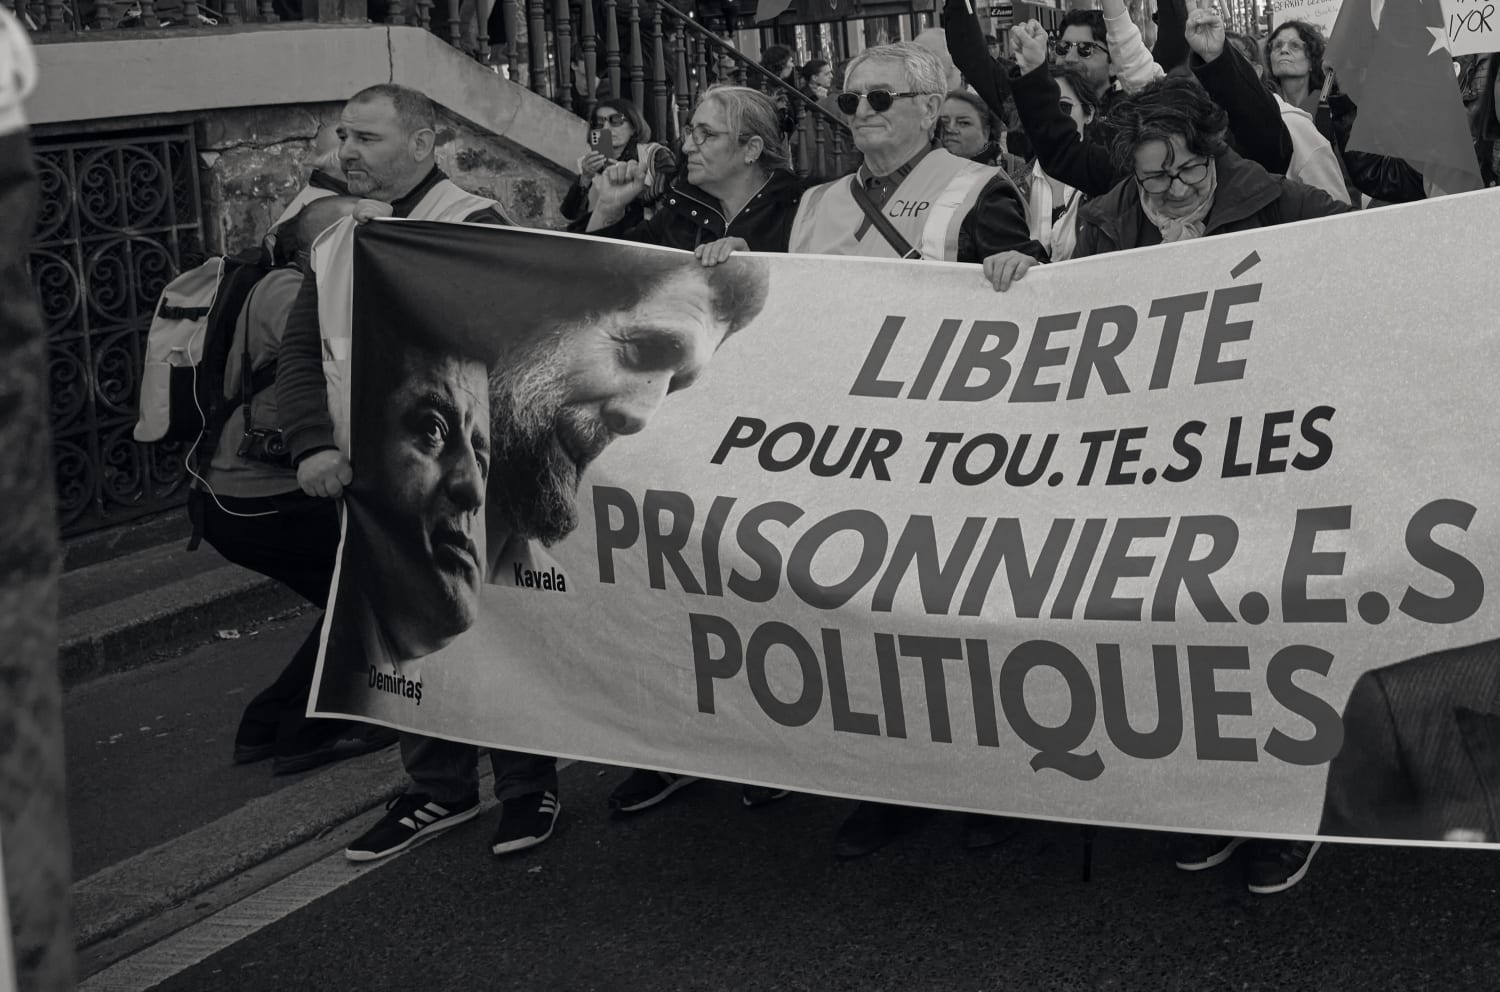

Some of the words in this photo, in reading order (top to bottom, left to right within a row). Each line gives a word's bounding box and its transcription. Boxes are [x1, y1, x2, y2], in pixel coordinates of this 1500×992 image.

[889, 199, 930, 218] CHP
[848, 251, 1263, 403] LIBERTÉ
[710, 416, 904, 483] POUR
[919, 420, 1204, 487] TOU.TE.S
[1220, 405, 1336, 478] LES
[513, 562, 567, 593] Kavala
[592, 486, 1485, 626] PRISONNIER.E.S
[368, 664, 423, 706] Demirtaş
[690, 612, 1345, 781] POLITIQUES
